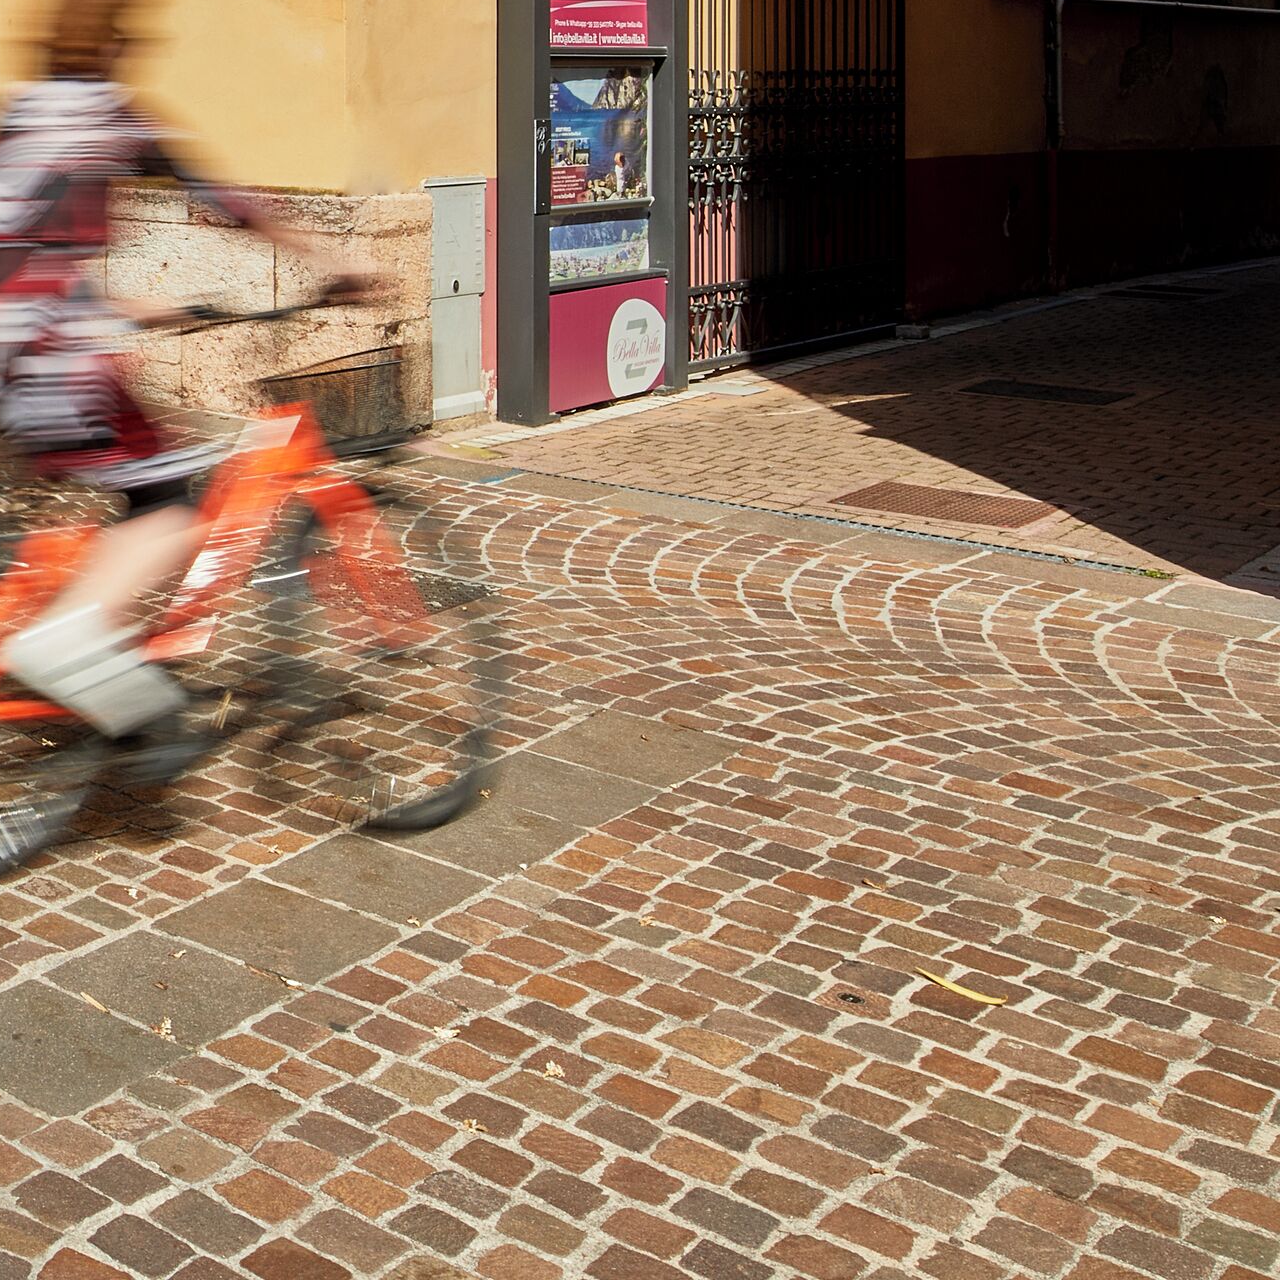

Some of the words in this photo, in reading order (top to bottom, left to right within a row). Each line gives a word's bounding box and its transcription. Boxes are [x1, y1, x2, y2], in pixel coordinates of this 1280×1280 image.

[552, 32, 597, 46] info@bellavilla.it
[601, 33, 646, 45] www.bellavilla.it
[612, 337, 639, 363] Bella
[639, 330, 661, 358] Villa
